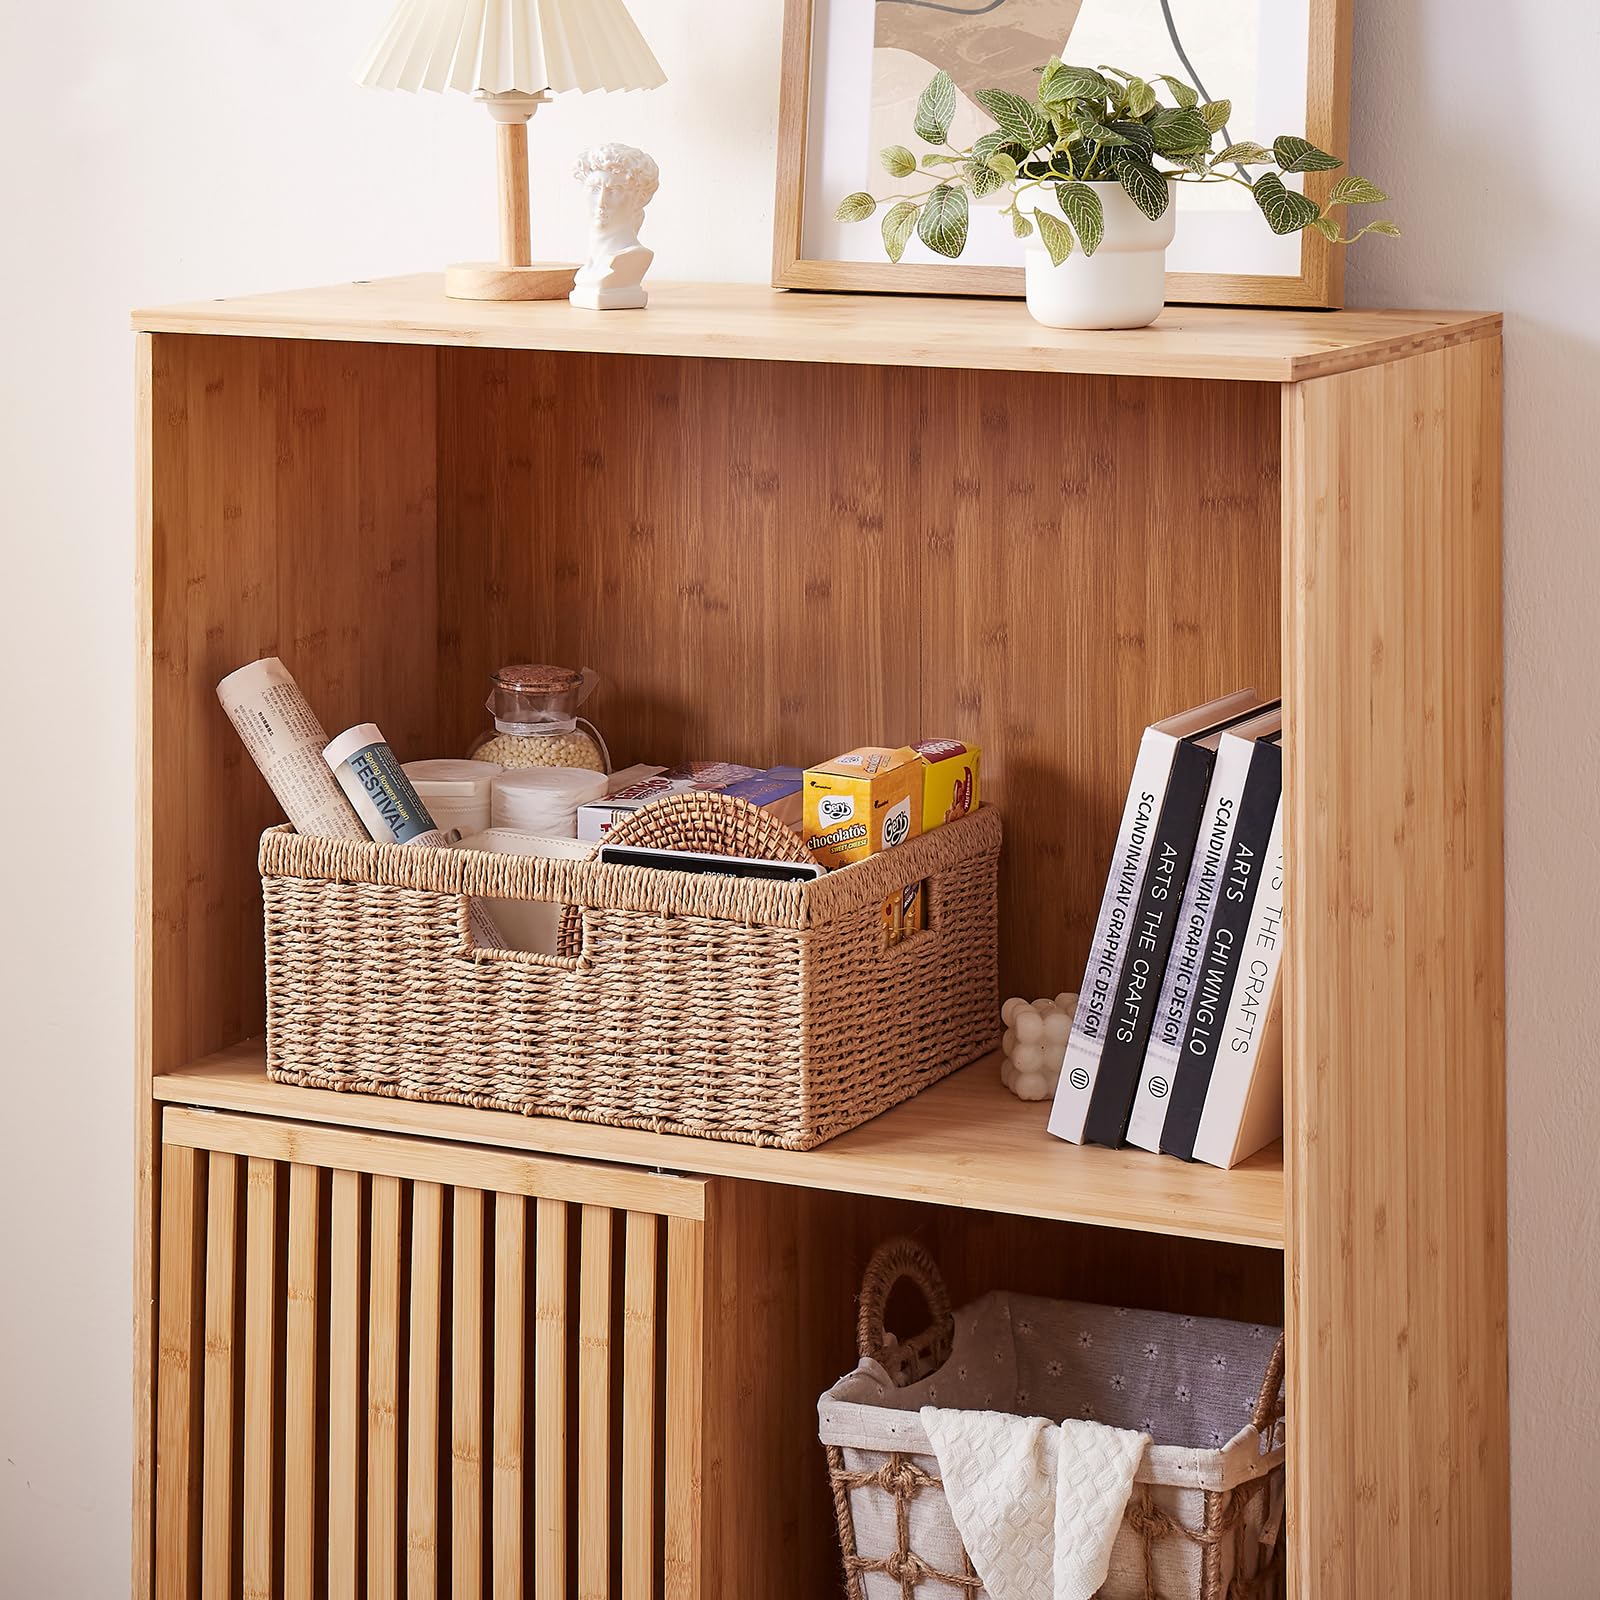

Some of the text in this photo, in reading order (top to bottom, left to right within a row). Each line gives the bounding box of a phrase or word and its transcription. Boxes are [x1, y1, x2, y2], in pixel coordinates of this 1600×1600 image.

[351, 755, 405, 838] FESTIVAL
[365, 751, 410, 820] Spring flowers Huan
[1083, 791, 1154, 1038] SCANDINAVIAV GRAPHIC DESIGN
[1116, 841, 1178, 1043] ARTS THE CRAFTS
[1162, 796, 1233, 1046] SCANDINAVIAV GRAPHIC DESIGN
[1189, 842, 1254, 1056] ARTS CHI WING LO
[1256, 906, 1283, 951] THE
[1231, 960, 1268, 1054] CRAFTS
